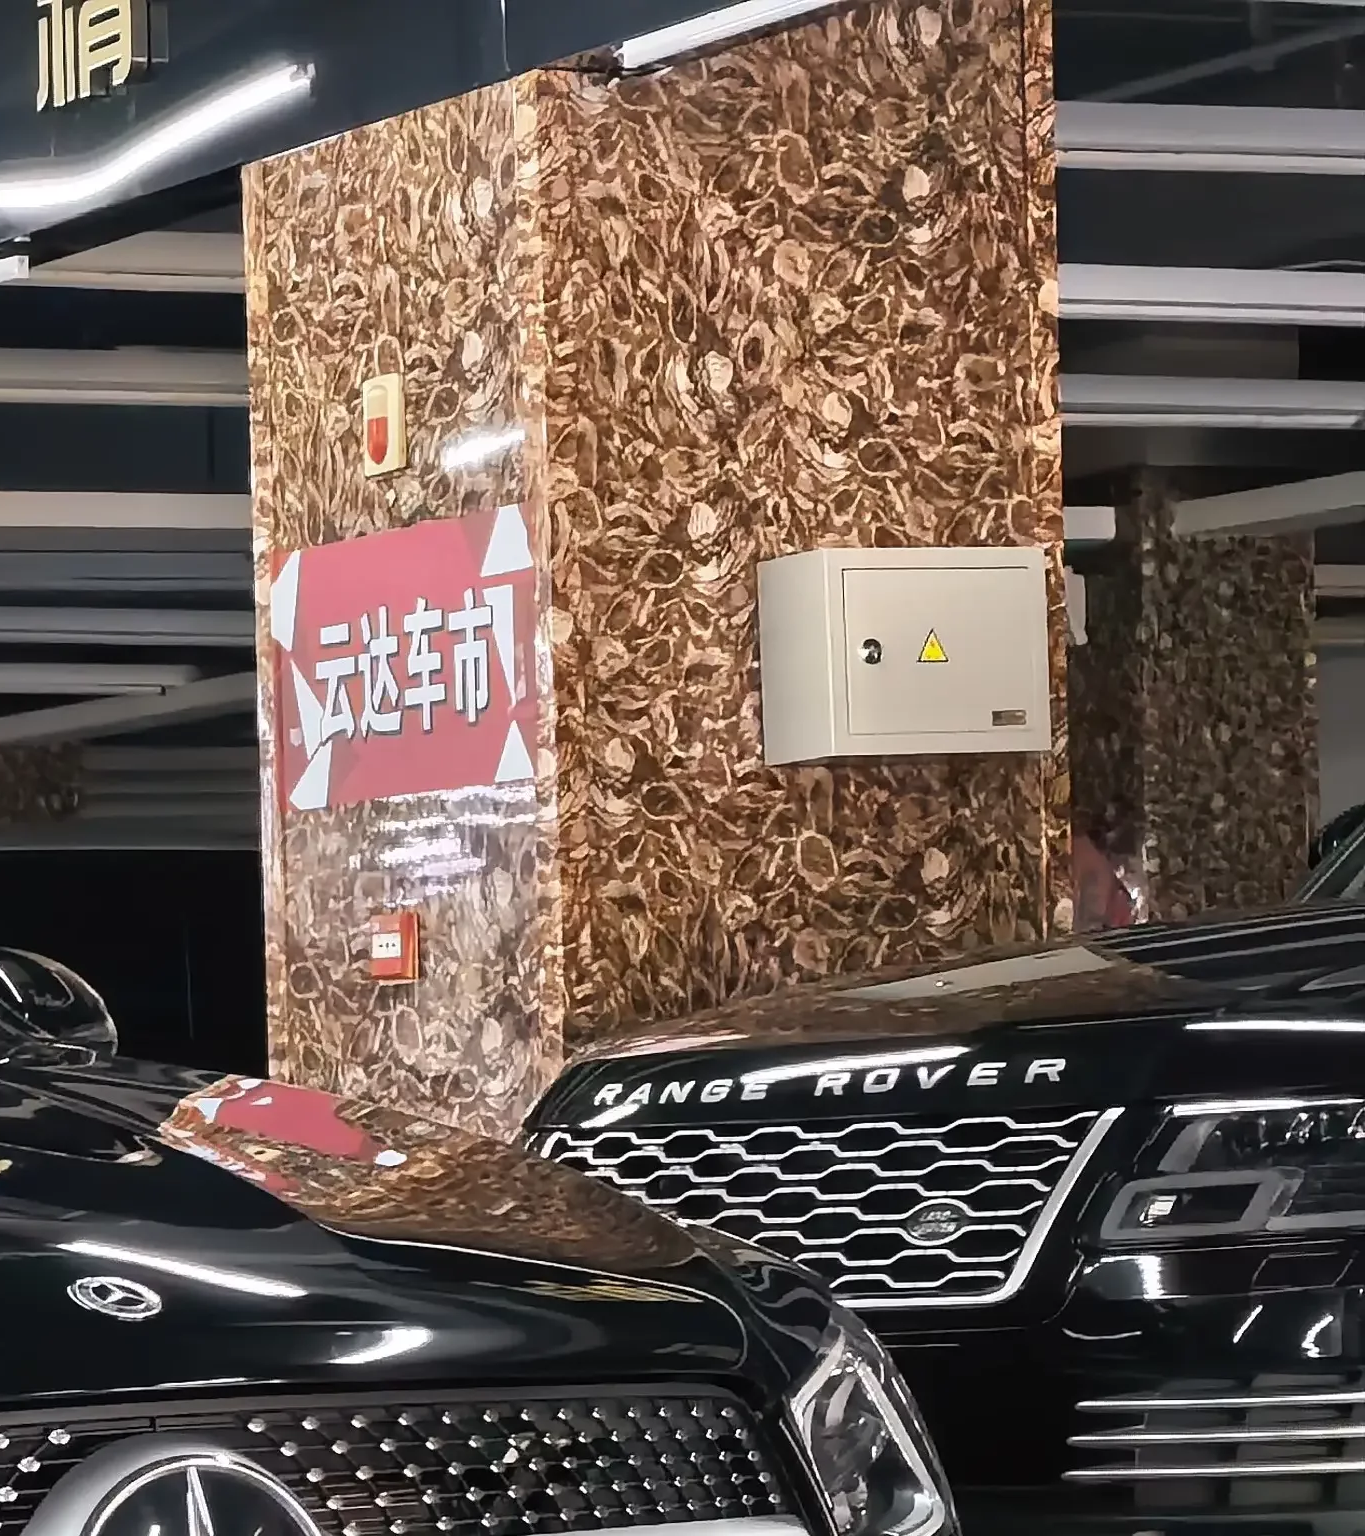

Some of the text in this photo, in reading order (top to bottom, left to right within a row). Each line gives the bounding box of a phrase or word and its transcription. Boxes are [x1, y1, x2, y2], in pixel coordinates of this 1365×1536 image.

[314, 587, 493, 742] 云达车市
[592, 1058, 1068, 1107] RANGE ROVER
